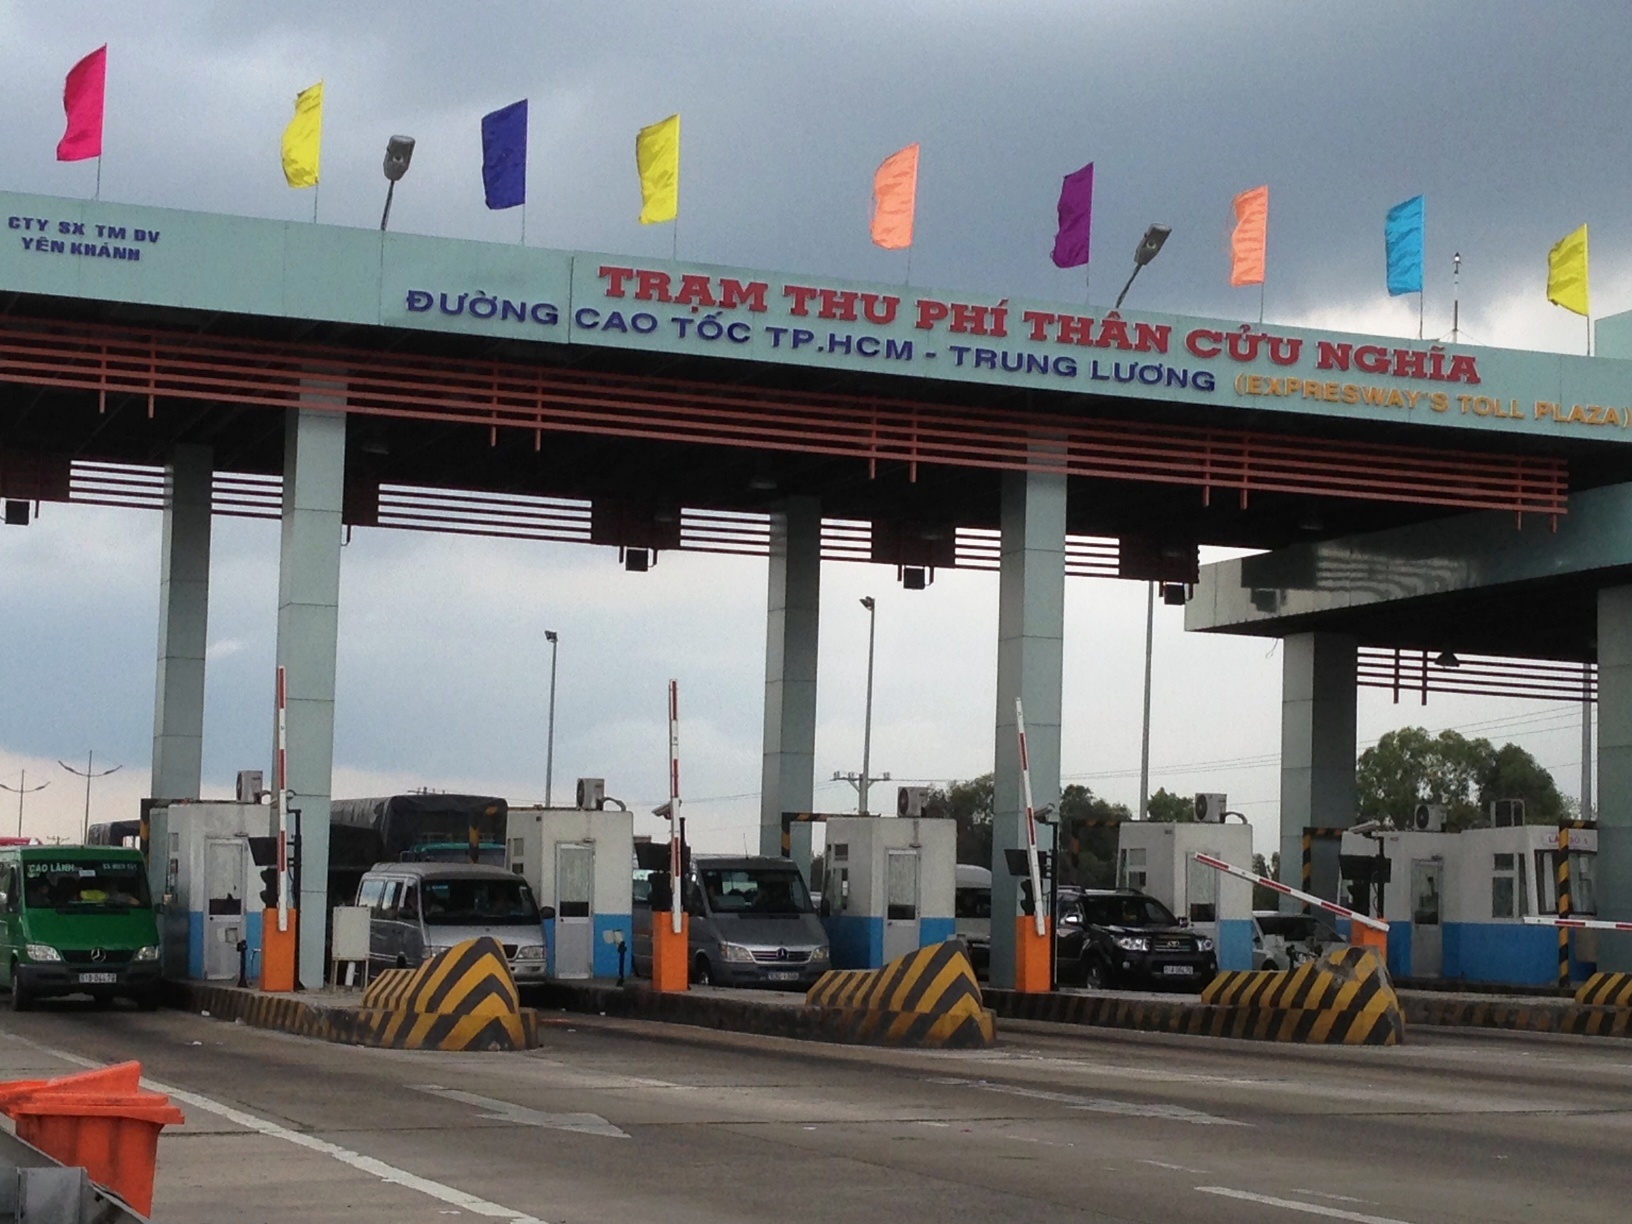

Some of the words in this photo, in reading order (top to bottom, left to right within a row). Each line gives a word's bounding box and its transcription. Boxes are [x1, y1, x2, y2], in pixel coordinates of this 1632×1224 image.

[7, 216, 50, 233] CTY
[57, 221, 86, 237] SX
[95, 224, 127, 241] TM
[21, 235, 66, 255] YÊN
[69, 241, 141, 262] KHÁNH
[406, 289, 560, 327] ĐƯỜNG
[571, 307, 660, 337] CAO
[671, 310, 753, 344] TỐC
[764, 326, 914, 362] TP.HCM
[950, 346, 1078, 379] TRUNG
[1091, 359, 1217, 393] LƯƠNG
[599, 266, 769, 313] TRẠM
[784, 285, 901, 324] THU
[916, 299, 1009, 337] PHÍ
[1024, 311, 1172, 353] THÂN
[1186, 323, 1303, 366] CỬU
[1317, 341, 1481, 384] NGHĨA
[1233, 373, 1450, 413] (EXPRESWAY'S
[1457, 394, 1526, 420] TOLL
[1534, 400, 1632, 429] PLAZA)
